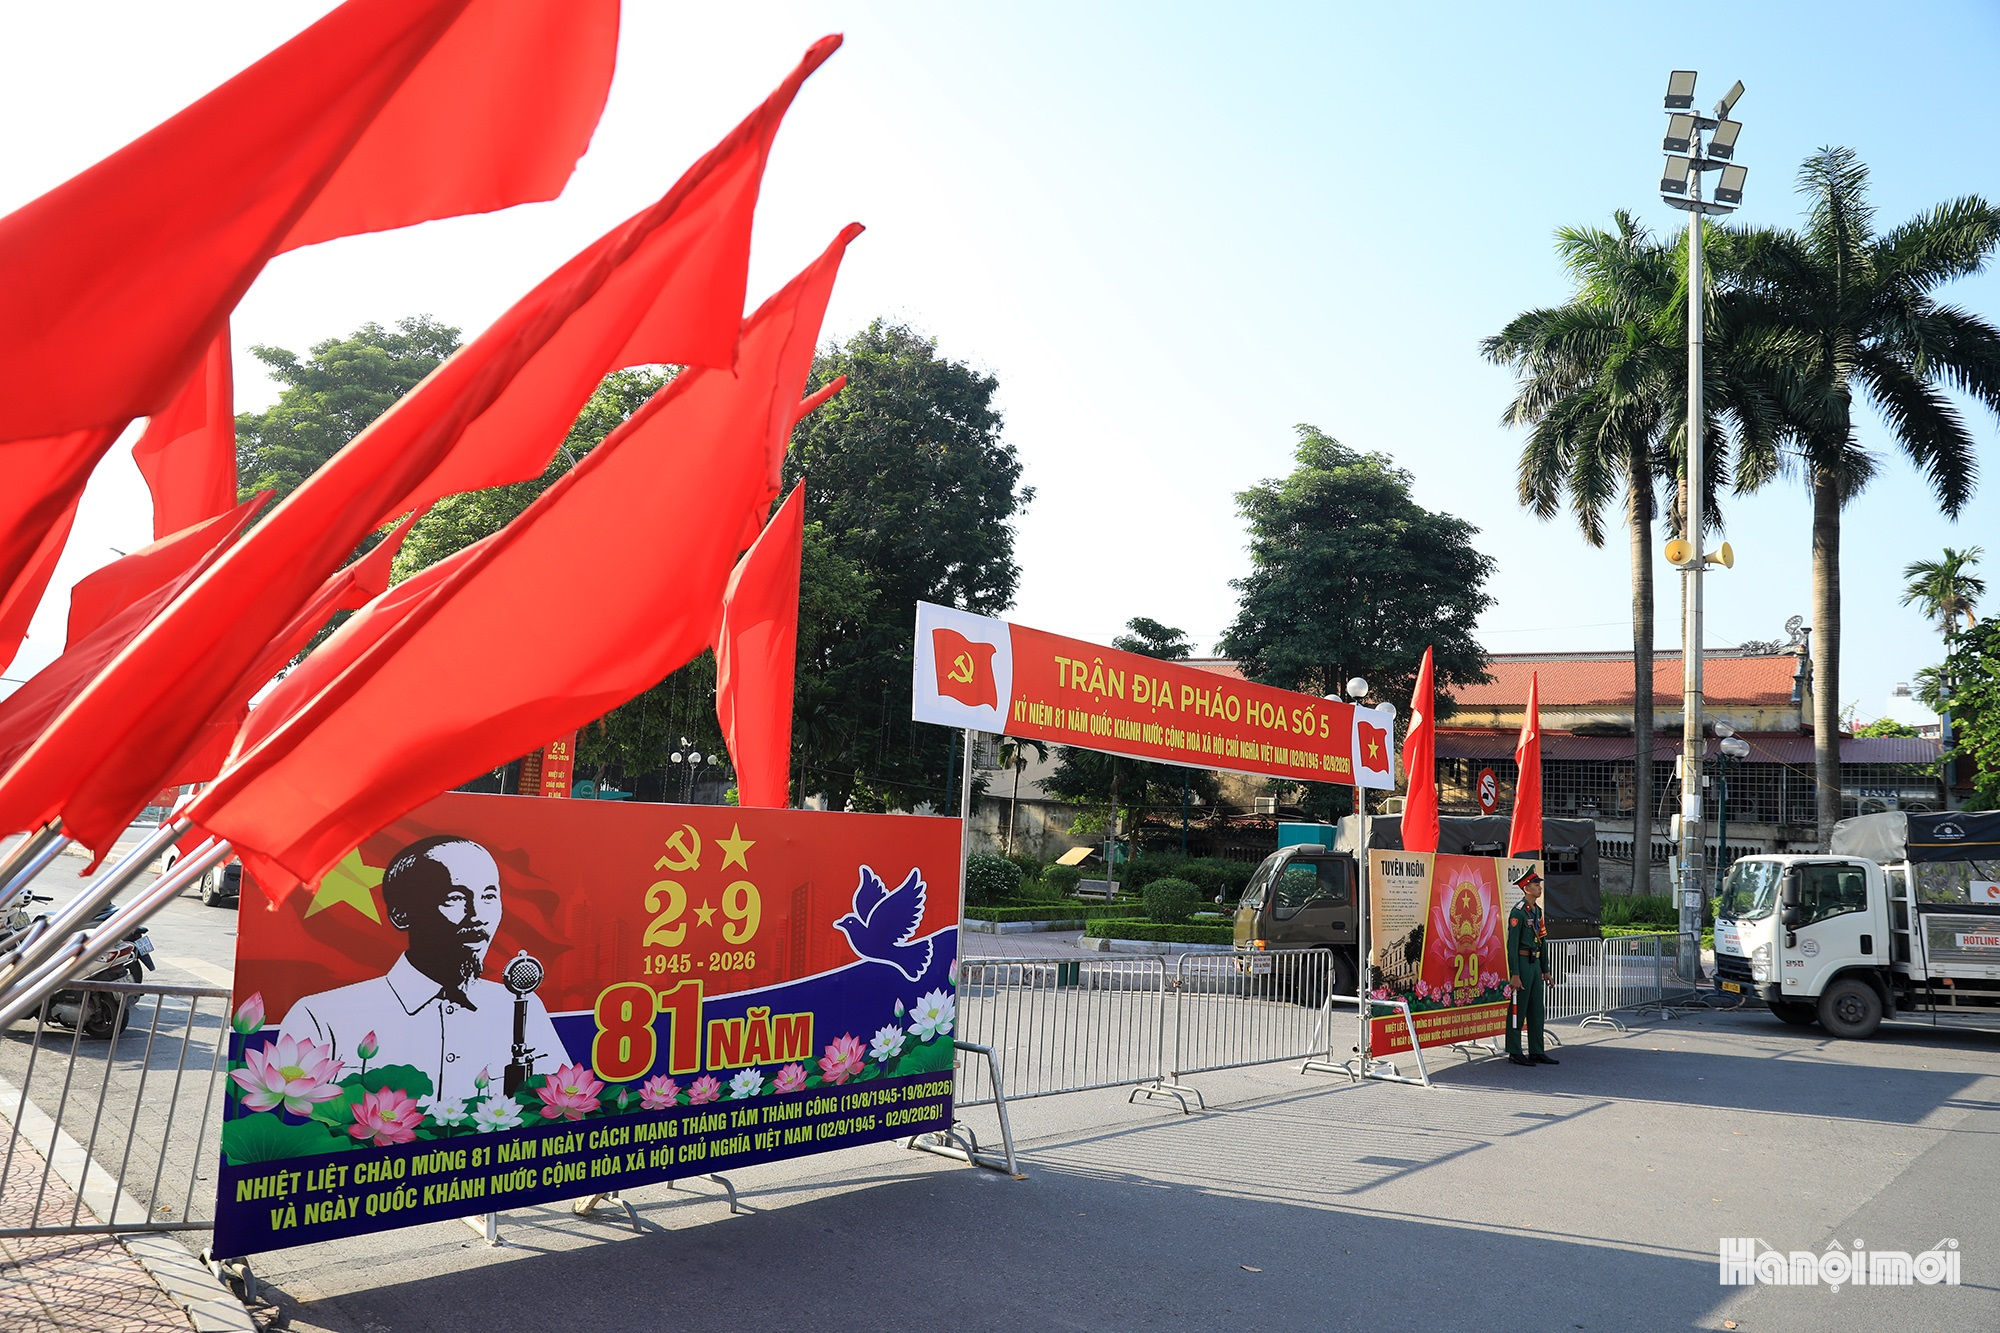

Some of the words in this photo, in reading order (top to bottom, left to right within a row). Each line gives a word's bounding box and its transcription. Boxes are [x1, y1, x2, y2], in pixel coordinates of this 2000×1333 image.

[1014, 694, 1027, 723] KỶ
[1029, 700, 1053, 730] NIỆM
[1054, 707, 1065, 729] 81
[1068, 706, 1089, 733] NĂM
[1090, 709, 1112, 737] QUỐC
[1114, 716, 1141, 742] KHÁNH
[1142, 722, 1164, 746] NƯỚC
[1165, 725, 1185, 752] CỘNG
[1202, 731, 1212, 753] XÃ
[1213, 733, 1224, 759] HỘI
[1226, 734, 1239, 758] CHỦ
[1240, 739, 1260, 761] NGHĨA
[1261, 741, 1273, 766] VIỆT
[1274, 746, 1289, 765] NAM
[1054, 655, 1125, 703] TRẬN
[1131, 673, 1175, 714] ĐỊA
[1180, 685, 1241, 722] PHÁO
[1246, 699, 1288, 732] HOA
[1291, 703, 1316, 737] SỐ
[1319, 714, 1330, 739] 5
[552, 741, 566, 754] 2-9
[1381, 858, 1404, 877] TUYÊN
[1405, 860, 1425, 877] NGÔN
[643, 953, 691, 975] 1945
[709, 951, 756, 971] 2026
[1963, 935, 1999, 946] HOTLINE
[591, 979, 704, 1083] 81
[706, 1006, 814, 1071] NĂM
[235, 1169, 302, 1202] NHIỆT
[306, 1163, 349, 1193] LIỆT
[354, 1155, 406, 1184] CHÀO
[411, 1149, 467, 1177] MỪNG
[471, 1146, 492, 1168] 81
[497, 1138, 537, 1164] NĂM
[541, 1130, 585, 1159] NGÀY
[588, 1126, 630, 1150] CÁCH
[634, 1119, 678, 1145] MẠNG
[681, 1108, 727, 1135] THÁNG
[730, 1104, 758, 1128] TÁM
[762, 1101, 803, 1123] THÀNH
[805, 1096, 838, 1116] CÔNG
[840, 1079, 953, 1113] (19/8/1945-19/8/2026)
[270, 1202, 298, 1231] VÀ
[303, 1193, 361, 1226] NGÀY
[365, 1182, 418, 1217] QUỐC
[423, 1176, 486, 1206] KHÁNH
[490, 1167, 537, 1195] NƯỚC
[542, 1160, 587, 1189] CỘNG
[590, 1153, 621, 1178] HÒA
[625, 1149, 646, 1172] XÃ
[650, 1144, 674, 1170] HỘI
[678, 1136, 707, 1163] CHỦ
[709, 1132, 751, 1159] NGHĨA
[754, 1126, 782, 1152] VIỆT
[784, 1125, 813, 1145] NAM
[816, 1114, 876, 1142] (02/9/1945
[885, 1103, 943, 1128] 02/9/2026)!
